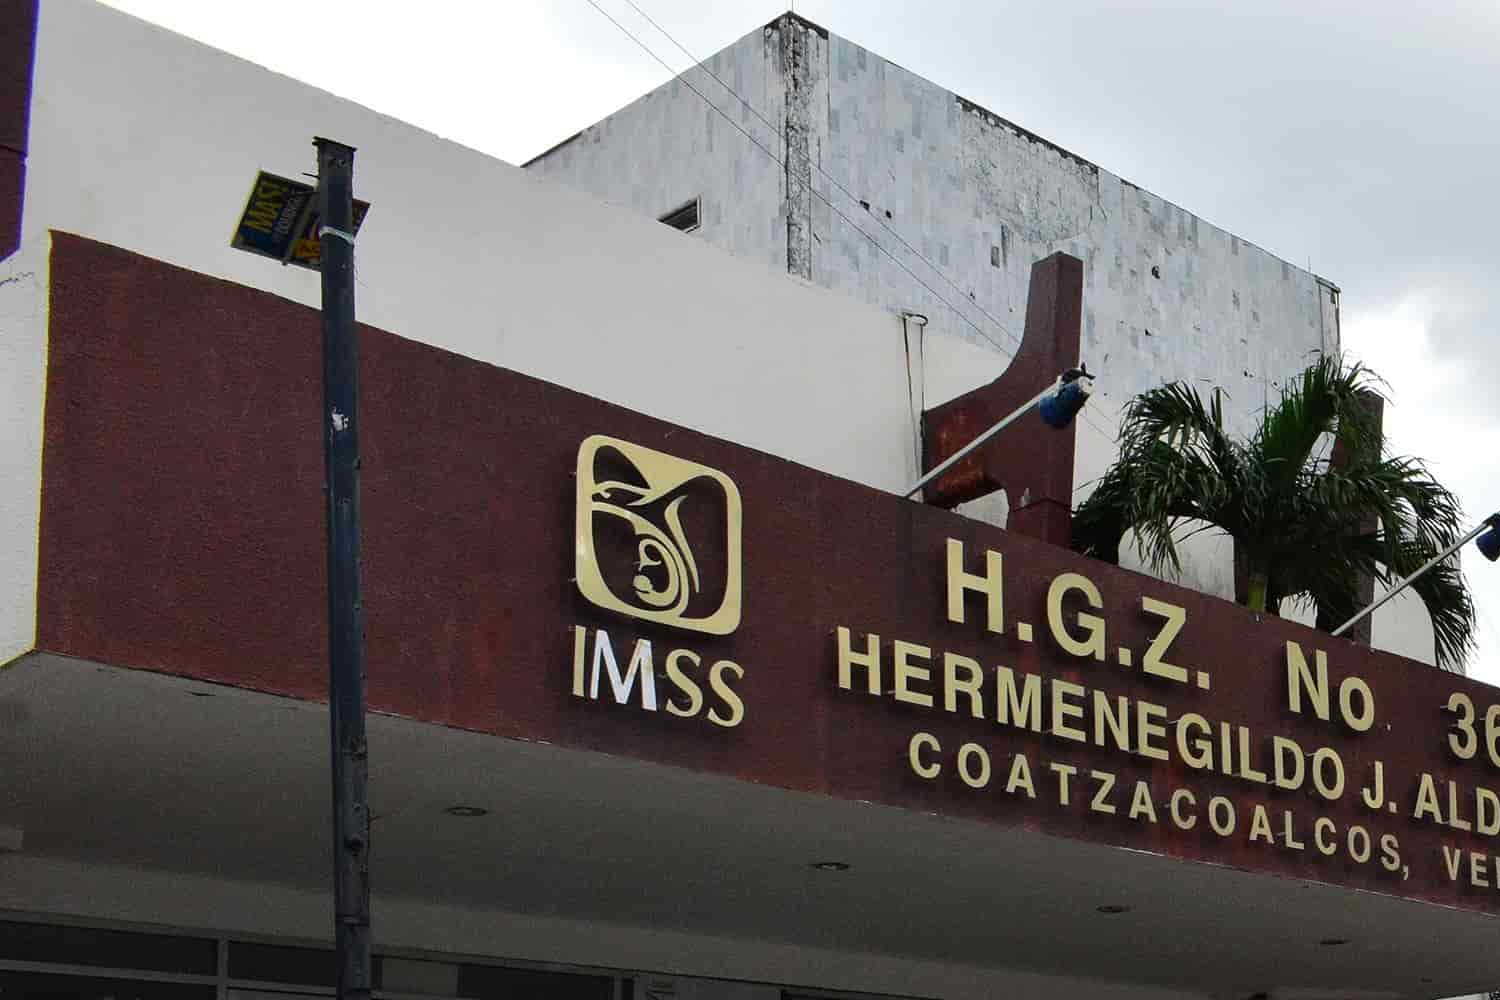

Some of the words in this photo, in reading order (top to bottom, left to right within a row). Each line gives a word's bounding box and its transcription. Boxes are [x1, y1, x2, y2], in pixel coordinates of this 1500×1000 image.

[573, 624, 745, 728] IMSS
[947, 538, 1210, 690] H.G.Z.
[837, 626, 1346, 800] HERMENEGILDO
[1361, 760, 1398, 813] J.
[909, 732, 1410, 882] COATZACOALCOS,
